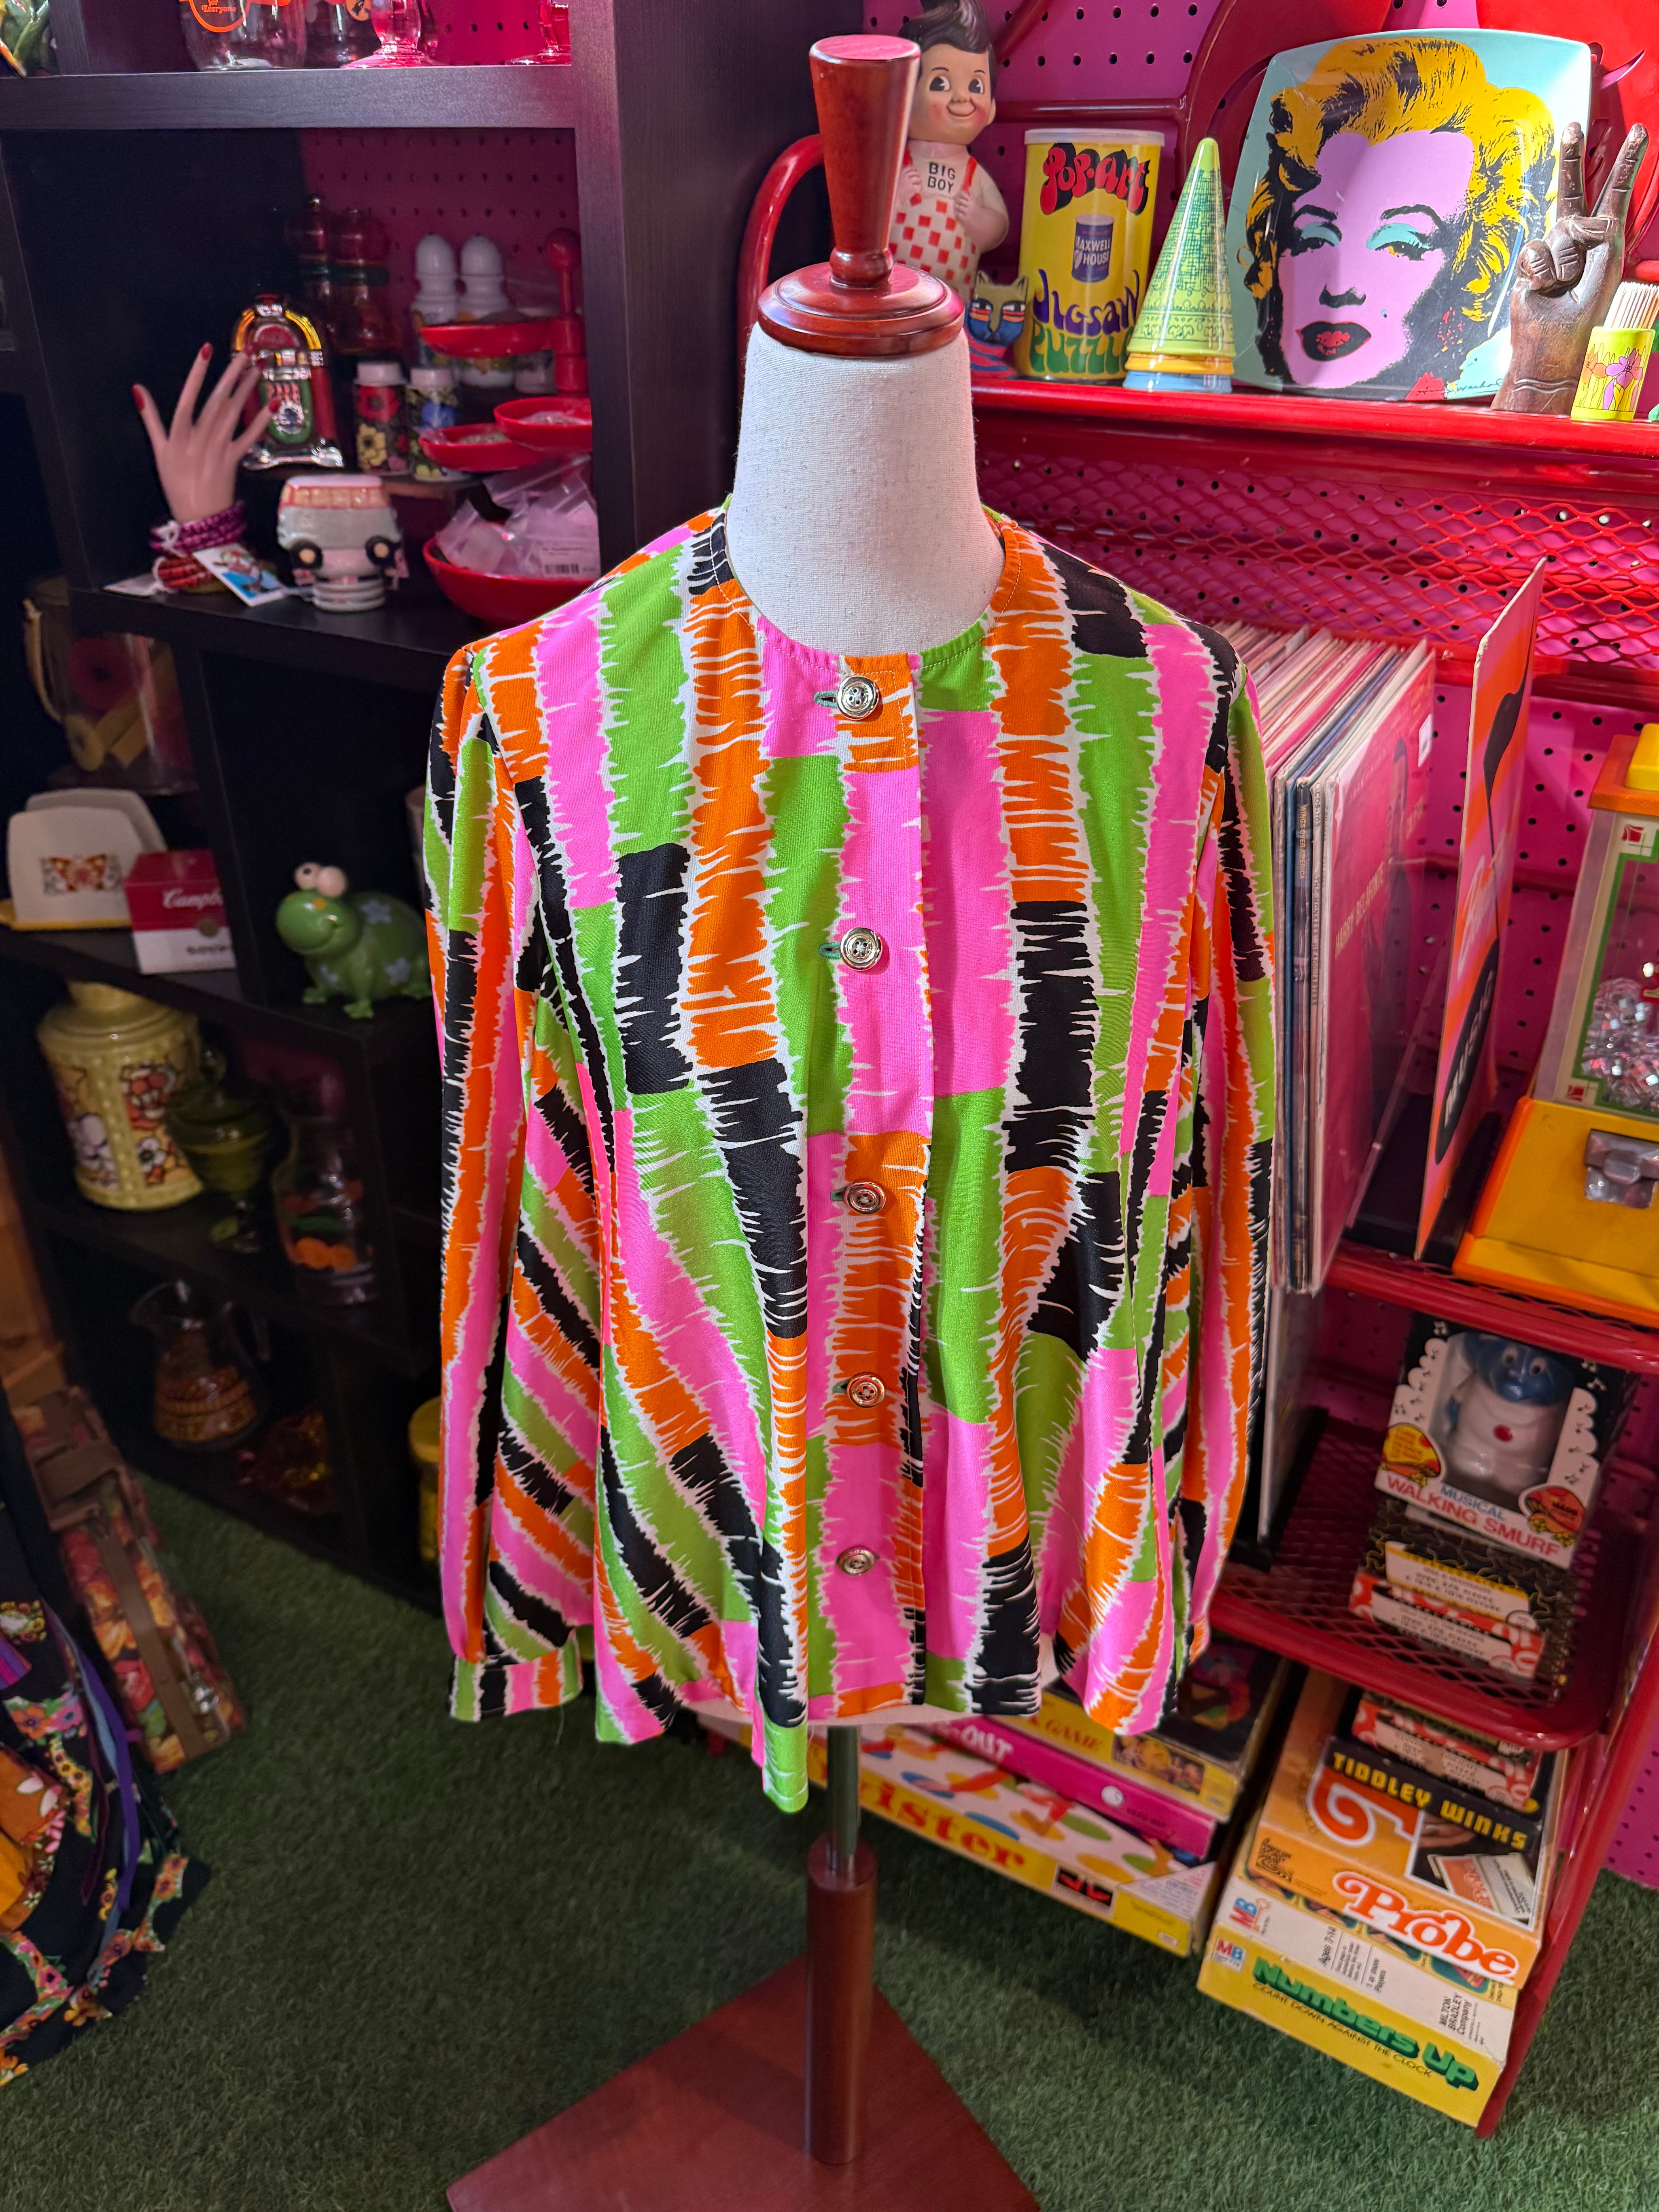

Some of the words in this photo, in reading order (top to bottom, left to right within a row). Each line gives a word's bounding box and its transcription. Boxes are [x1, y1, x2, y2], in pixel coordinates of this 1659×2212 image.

[201, 5, 236, 14] Everyone
[927, 176, 954, 193] BOY
[929, 162, 955, 179] BIG
[1075, 236, 1111, 252] MAXWELL
[1083, 251, 1110, 266] HOUSE
[1386, 1474, 1478, 1525] WALKING
[1483, 1518, 1561, 1557] SMURF
[1440, 1486, 1506, 1521] MUSICAL
[1045, 1720, 1102, 1750] GAME
[1333, 1751, 1432, 1808] TIDDLEY
[1440, 1800, 1527, 1851] WINKS
[1229, 1896, 1259, 1930] MB
[1332, 1871, 1519, 1977] Probe
[1216, 1938, 1243, 1961] MB
[1318, 1944, 1331, 1967] Ages
[1253, 1956, 1420, 2059] Numbers
[1421, 2042, 1479, 2092] Up
[1438, 1996, 1452, 2026] MILTON
[1447, 1991, 1463, 2032] BRADLEY
[1456, 1999, 1473, 2035] Company
[1253, 1983, 1288, 2004] COUNT
[1291, 2000, 1325, 2025] DOWN
[1328, 2021, 1371, 2049] AGAINST
[1374, 2039, 1391, 2057] THE
[1392, 2053, 1433, 2078] CLOCK
